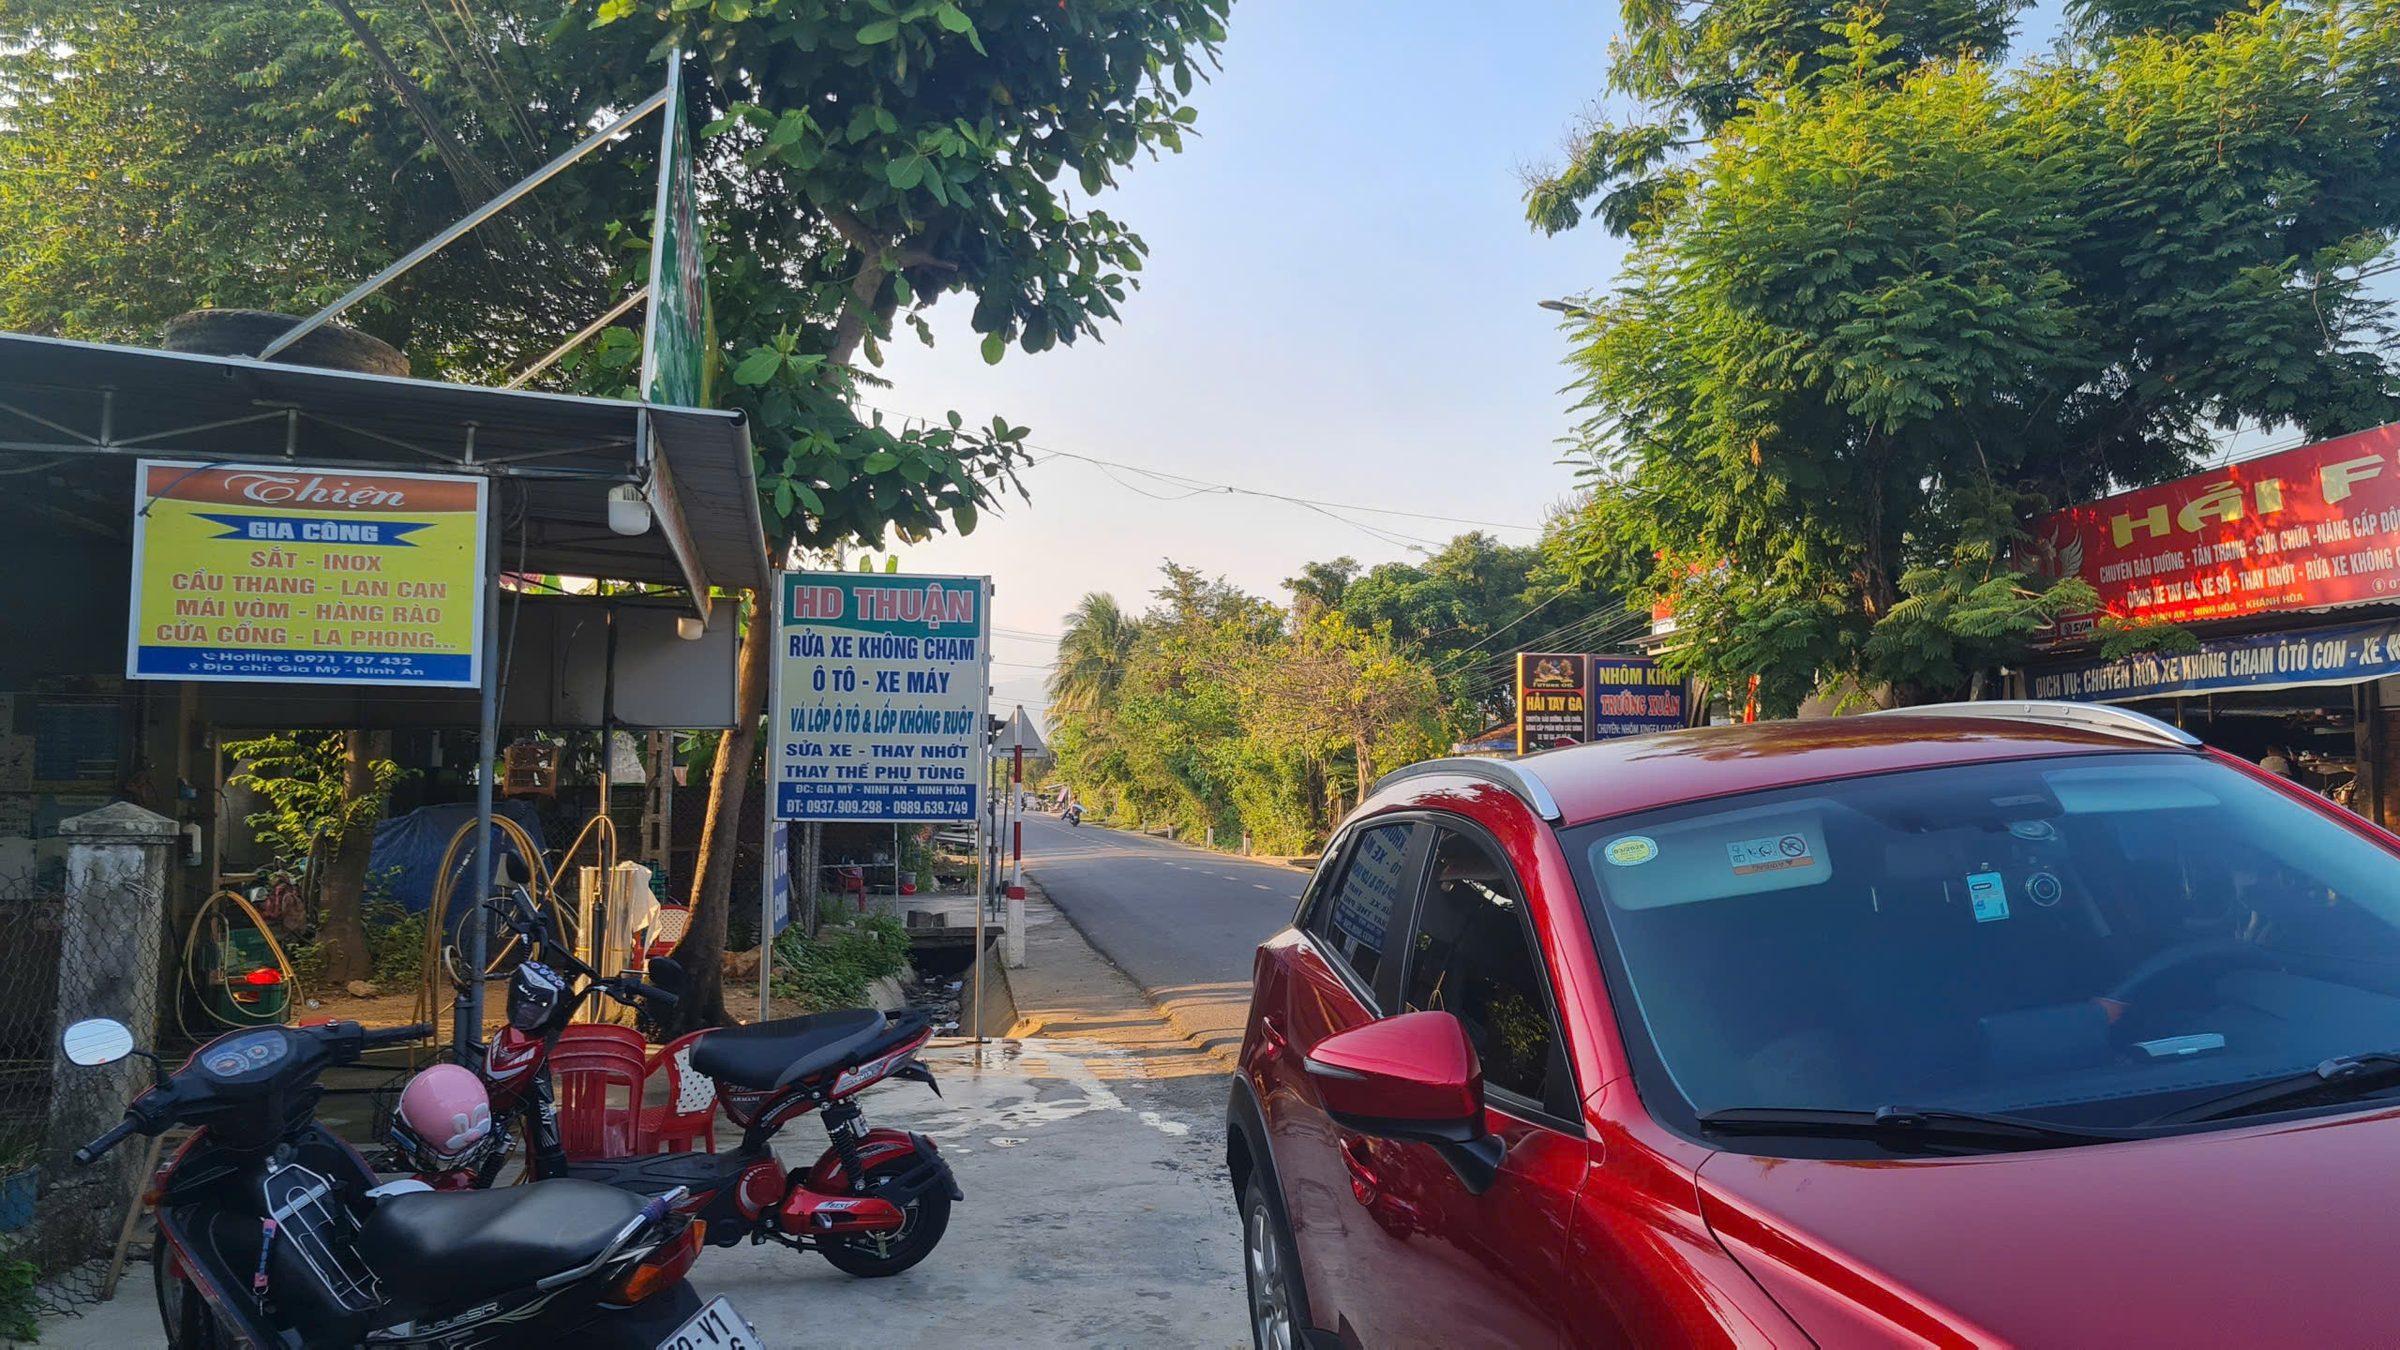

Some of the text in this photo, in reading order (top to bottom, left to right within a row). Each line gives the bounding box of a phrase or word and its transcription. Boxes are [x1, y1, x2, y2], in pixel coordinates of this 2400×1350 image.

[224, 473, 406, 508] Thiện
[2111, 480, 2283, 549] HẢI
[248, 520, 380, 542] GIA CÔNG
[250, 545, 298, 569] SẮT
[323, 554, 382, 572] INOX
[2100, 558, 2133, 584] CHUYÊN
[2133, 553, 2151, 577] BẢO
[2152, 550, 2185, 575] DƯỠNG
[2212, 539, 2248, 563] TRANG
[2255, 528, 2279, 556] SỬA
[2280, 524, 2311, 551] CHỮA
[2352, 508, 2378, 538] CẤP
[232, 575, 315, 594] THANG
[341, 580, 389, 598] LAN
[397, 581, 447, 599] CAN
[2152, 585, 2167, 605] XE
[2166, 581, 2183, 604] TAY
[2201, 577, 2216, 598] XE
[2216, 567, 2231, 595] SỐ
[2238, 566, 2265, 592] THAY
[2265, 560, 2296, 588] NHỚT
[2304, 552, 2331, 582] RỬA
[2332, 555, 2349, 577] XE
[2349, 547, 2394, 575] KHÔNG
[175, 597, 225, 617] MÁI
[234, 598, 290, 619] VÒM
[315, 602, 384, 623] HÀNG
[392, 603, 441, 624] RÀO
[793, 582, 975, 630] HD THUẬN
[2193, 606, 2217, 617] NINH
[2245, 597, 2281, 610] KHÁNH
[156, 619, 209, 642] CỬA
[217, 620, 287, 644] CỔNG
[313, 628, 342, 646] LA
[789, 627, 975, 665] RỬA XE KHÔNG CHẠM
[203, 663, 234, 673] Địa
[239, 663, 274, 672] chỉ:
[277, 664, 310, 673] Gia
[315, 665, 341, 675] Mỹ
[356, 665, 396, 675] Ninh
[400, 667, 425, 676] An
[219, 653, 413, 666] Hotline: 0971 787 432
[2160, 657, 2180, 684] XE
[2181, 643, 2228, 681] KHÔNG
[2230, 646, 2275, 681] CHẠM
[2311, 639, 2348, 670] CON
[2359, 636, 2384, 665] XE
[812, 665, 826, 692] Ô
[832, 665, 856, 693] TÔ
[875, 671, 901, 693] XE
[906, 667, 951, 694] MÁY
[1599, 664, 1643, 685] NHÔM
[1526, 692, 1584, 712] HẢI TAY GA
[1647, 689, 1681, 717] XUÂN
[789, 697, 975, 742] VÁ LỐP Ô TÔ & LỐP KHÔNG RUỘT
[785, 739, 824, 757] SỬA
[829, 743, 852, 758] XE
[871, 744, 915, 758] THAY
[920, 742, 970, 759] NHỚT
[785, 762, 966, 782] THAY THẾ PHỤ TÙNG
[795, 785, 814, 794] ĐC:
[816, 785, 834, 794] GIA
[837, 784, 854, 794] MỸ
[863, 785, 890, 795] NINH
[892, 785, 908, 795] AN
[917, 785, 943, 795] NINH
[786, 800, 804, 813] ĐT:
[806, 800, 883, 814] 0937.909.298
[893, 800, 969, 815] 0989.639.749
